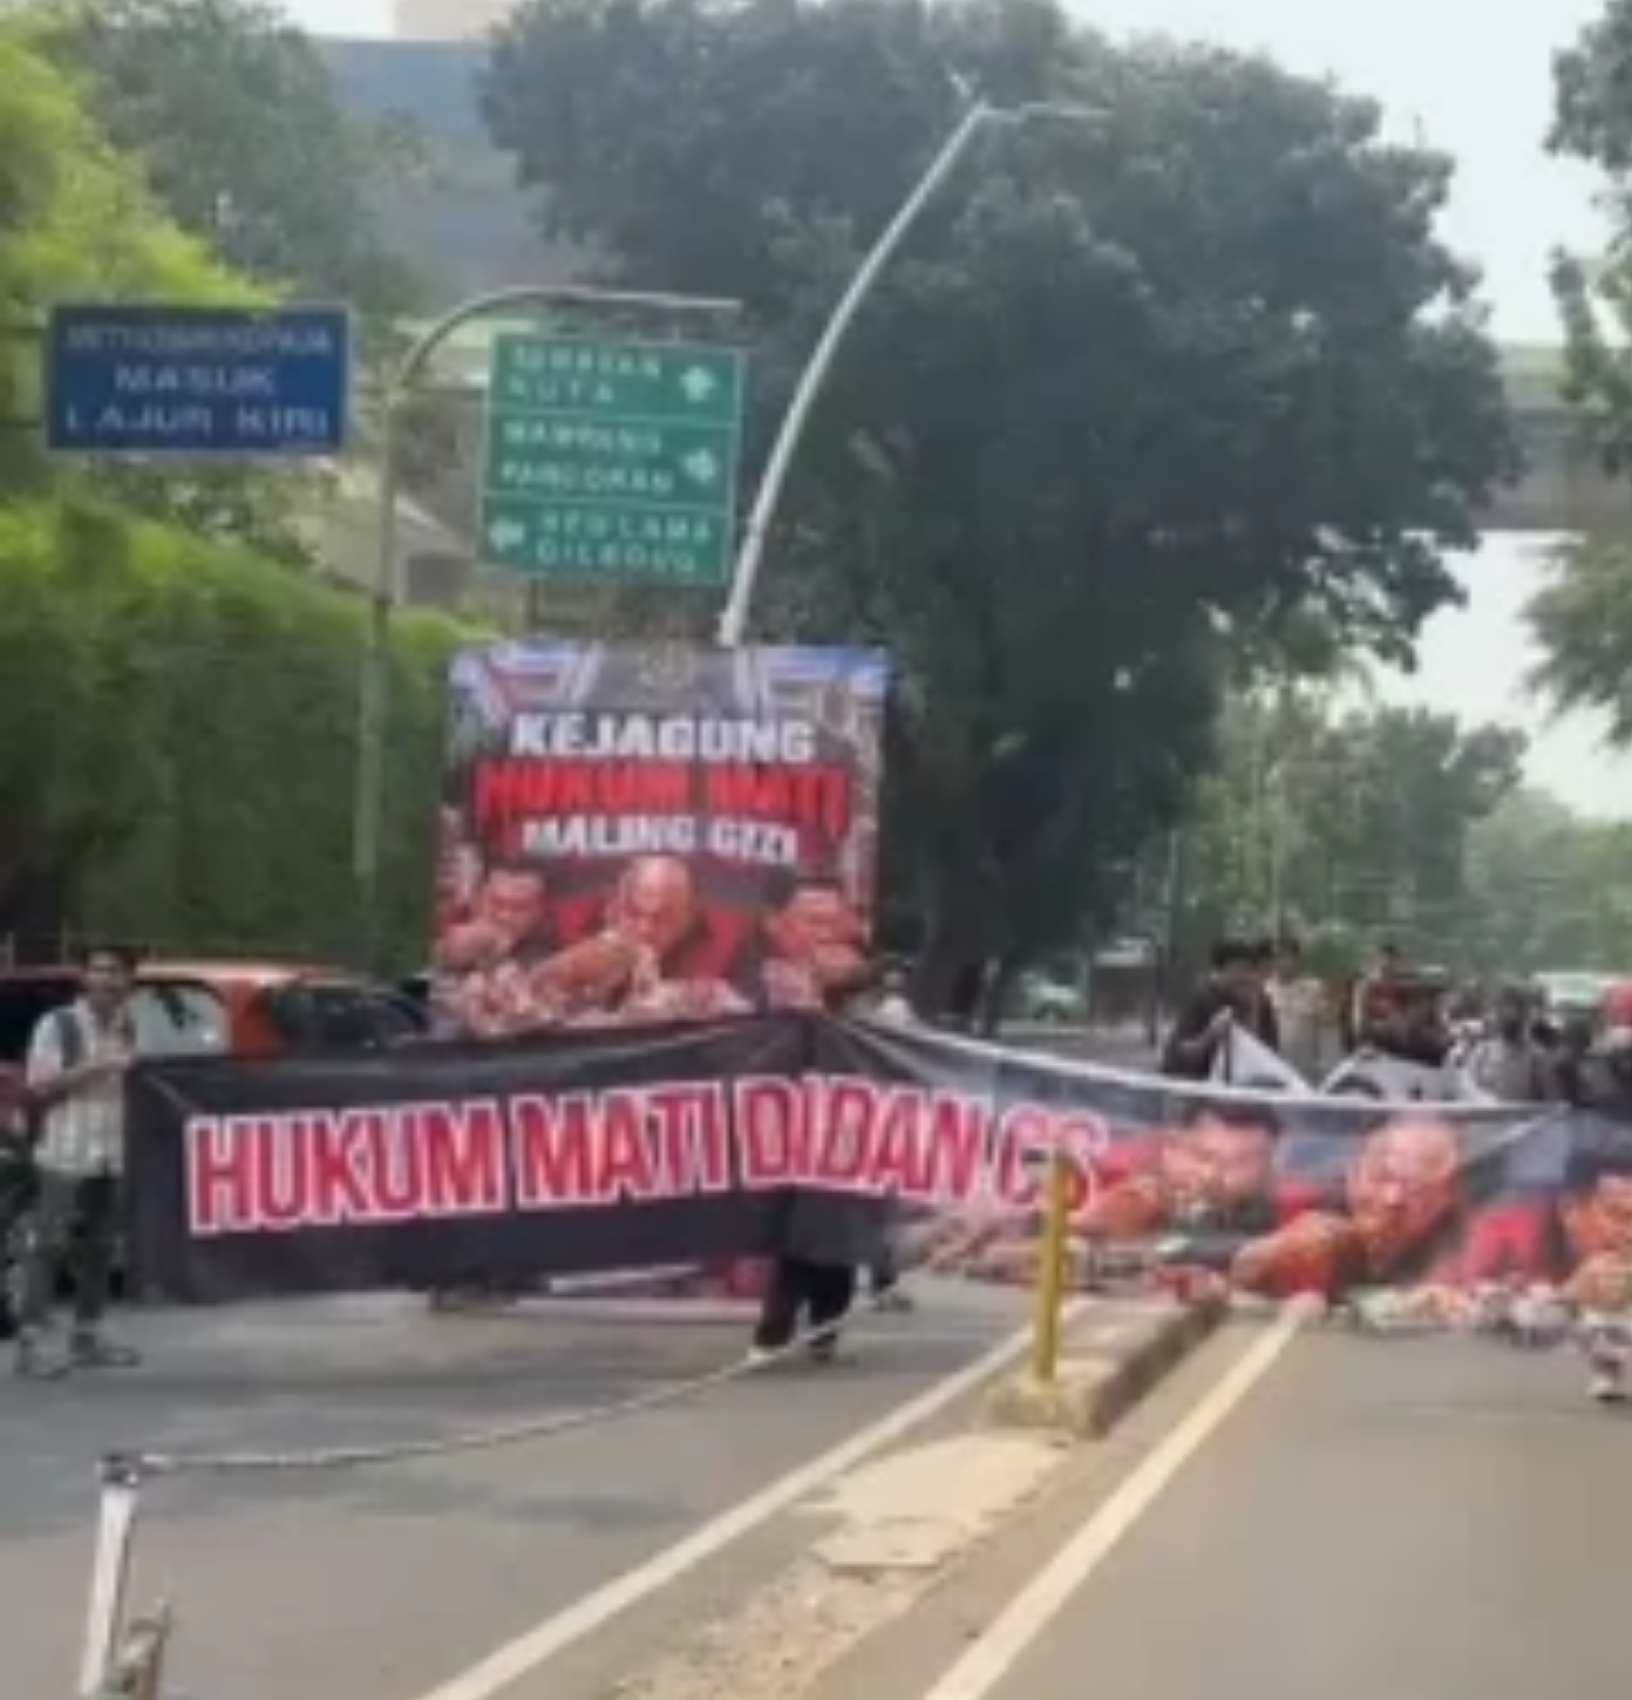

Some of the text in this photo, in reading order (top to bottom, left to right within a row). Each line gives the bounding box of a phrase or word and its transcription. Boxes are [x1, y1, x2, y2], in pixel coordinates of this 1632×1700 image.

[114, 364, 275, 395] MASUK
[65, 402, 329, 438] LAJUR KIRI
[513, 713, 815, 762] KEJAGUNG
[521, 814, 800, 866] MALING GIZI
[187, 1098, 503, 1233] HUKUM
[514, 1080, 728, 1208] MATI
